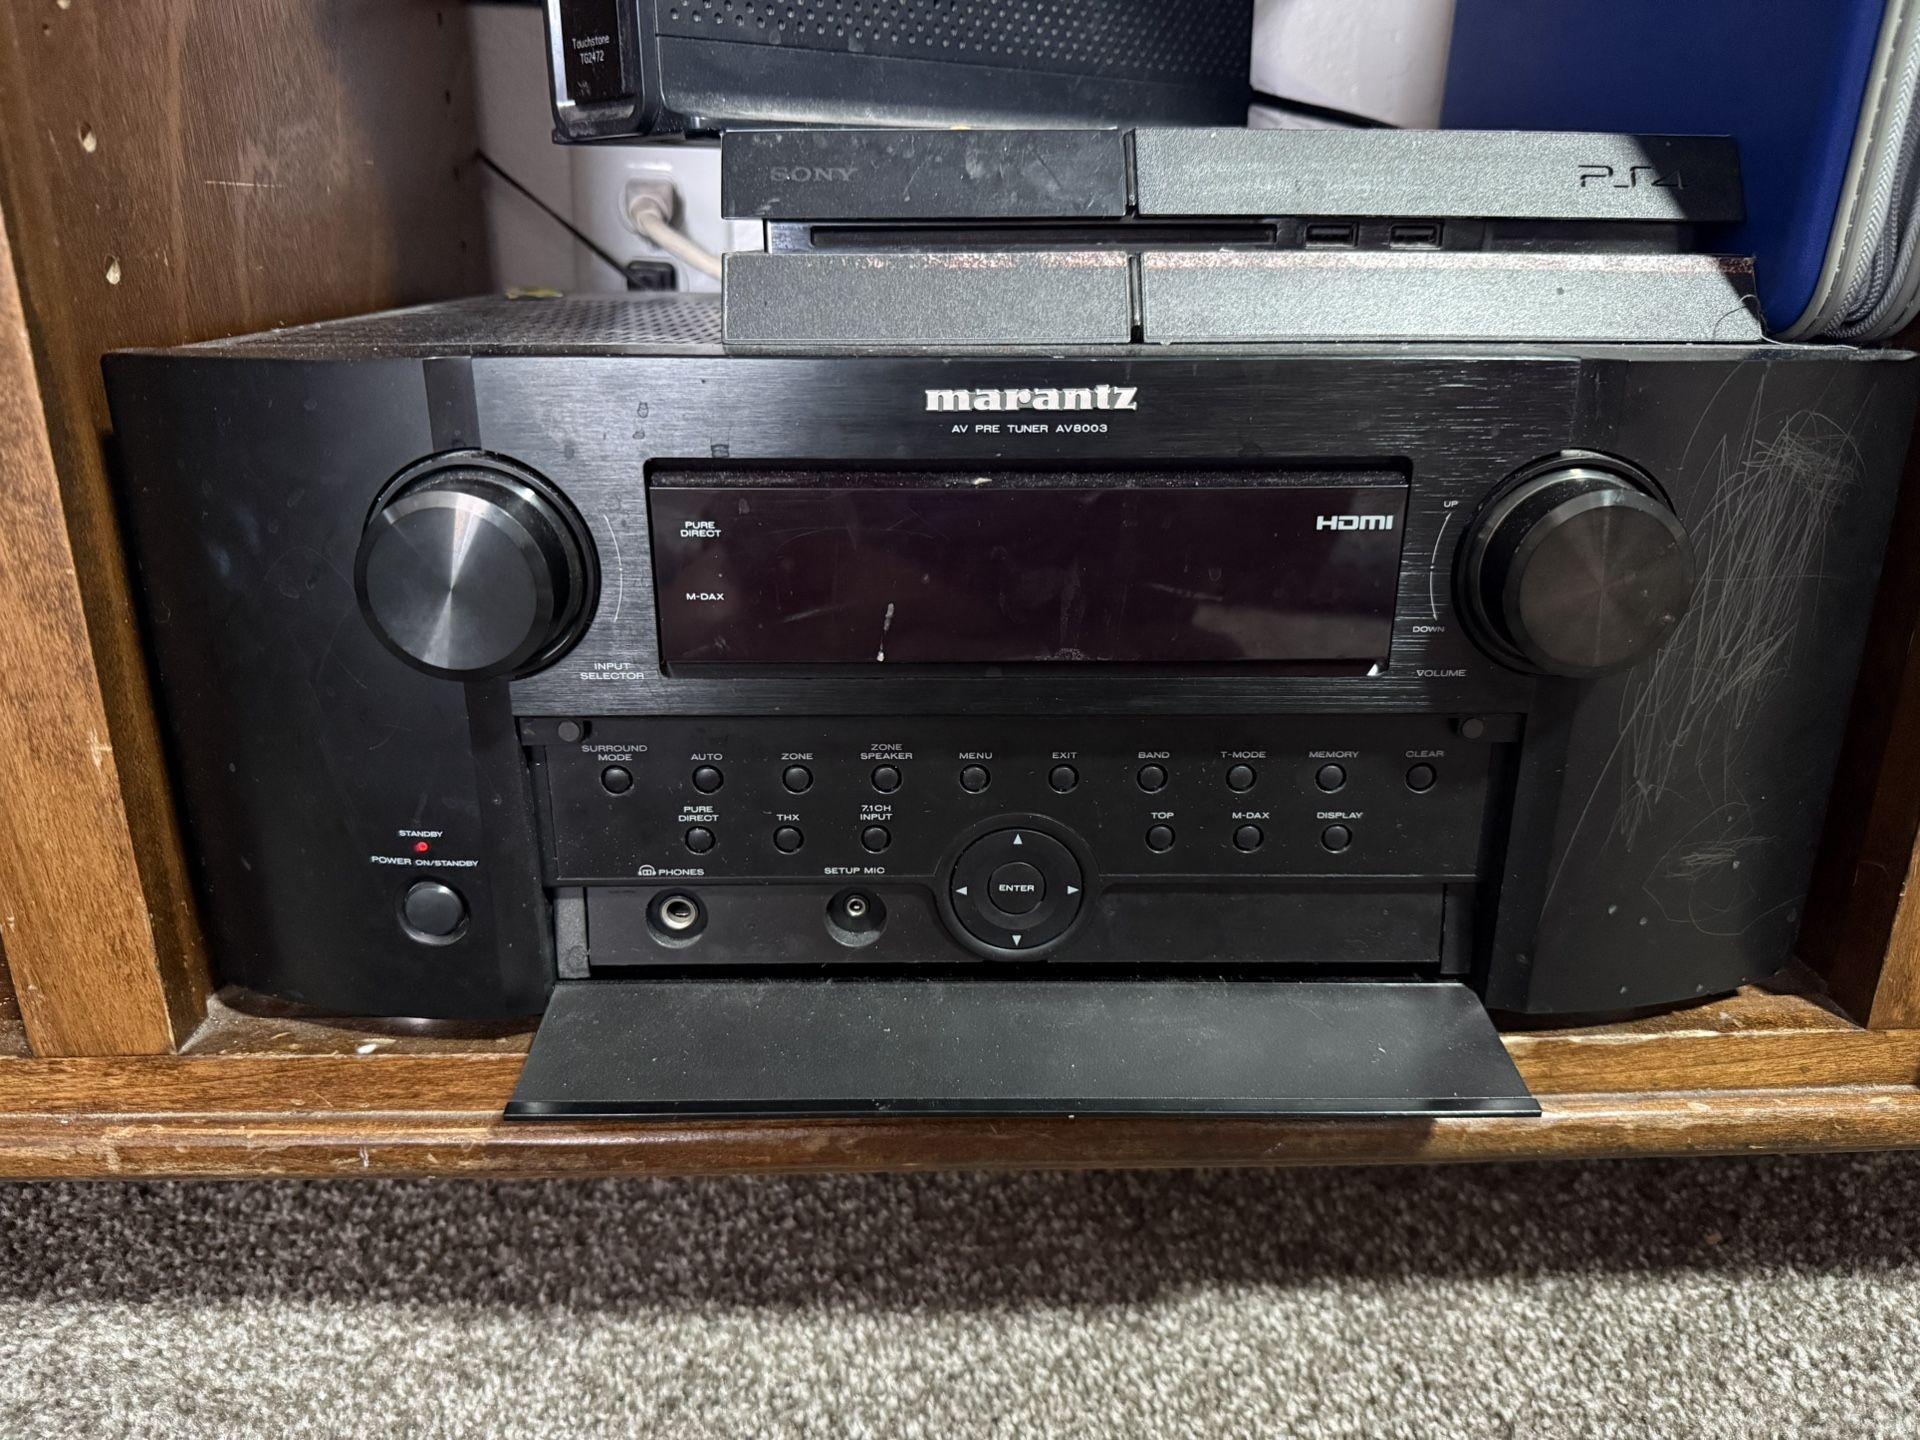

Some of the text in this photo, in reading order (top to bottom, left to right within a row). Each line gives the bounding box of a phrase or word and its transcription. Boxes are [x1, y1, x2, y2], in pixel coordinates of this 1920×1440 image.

[571, 35, 610, 49] Touchstone
[579, 50, 605, 65] TG2472
[769, 167, 858, 183] SONY
[1578, 164, 1688, 190] PS4
[925, 384, 1137, 413] marantz
[951, 424, 1108, 434] AV PRE TUNER AV8003
[1443, 500, 1459, 508] UP
[684, 521, 716, 530] PURE
[1315, 515, 1394, 531] HDMI
[680, 529, 722, 538] DIRECT
[686, 593, 725, 601] M-DAX
[594, 662, 631, 671] INPUT
[580, 672, 645, 680] SELECTOR
[1416, 669, 1467, 677] VOLUME
[581, 744, 648, 752] SURROUND
[870, 743, 902, 751] ZONE
[597, 754, 633, 762] MODE
[690, 753, 723, 761] AUTO
[781, 753, 813, 761] ZONE
[860, 752, 913, 760] SPEAKER
[959, 752, 993, 760] MENU
[1052, 751, 1078, 759] EXIT
[1138, 751, 1170, 759] BAND
[1220, 751, 1266, 759] T-MODE
[1308, 751, 1360, 759] MEMORY
[1405, 750, 1445, 758] CLEAR
[683, 805, 714, 813] PURE
[861, 804, 892, 812] 7.1CH
[678, 814, 720, 822] DIRECT
[776, 814, 800, 822] THX
[860, 813, 893, 821] INPUT
[1150, 811, 1174, 820] TOP
[1232, 811, 1270, 819] M-DAX
[1316, 811, 1364, 820] DISPLAY
[398, 830, 443, 838] STANDBY
[370, 855, 479, 868] POWER ON/STANDBY
[658, 868, 705, 877] PHONES
[824, 866, 885, 875] SETUP MIC
[998, 884, 1035, 892] ENTER
